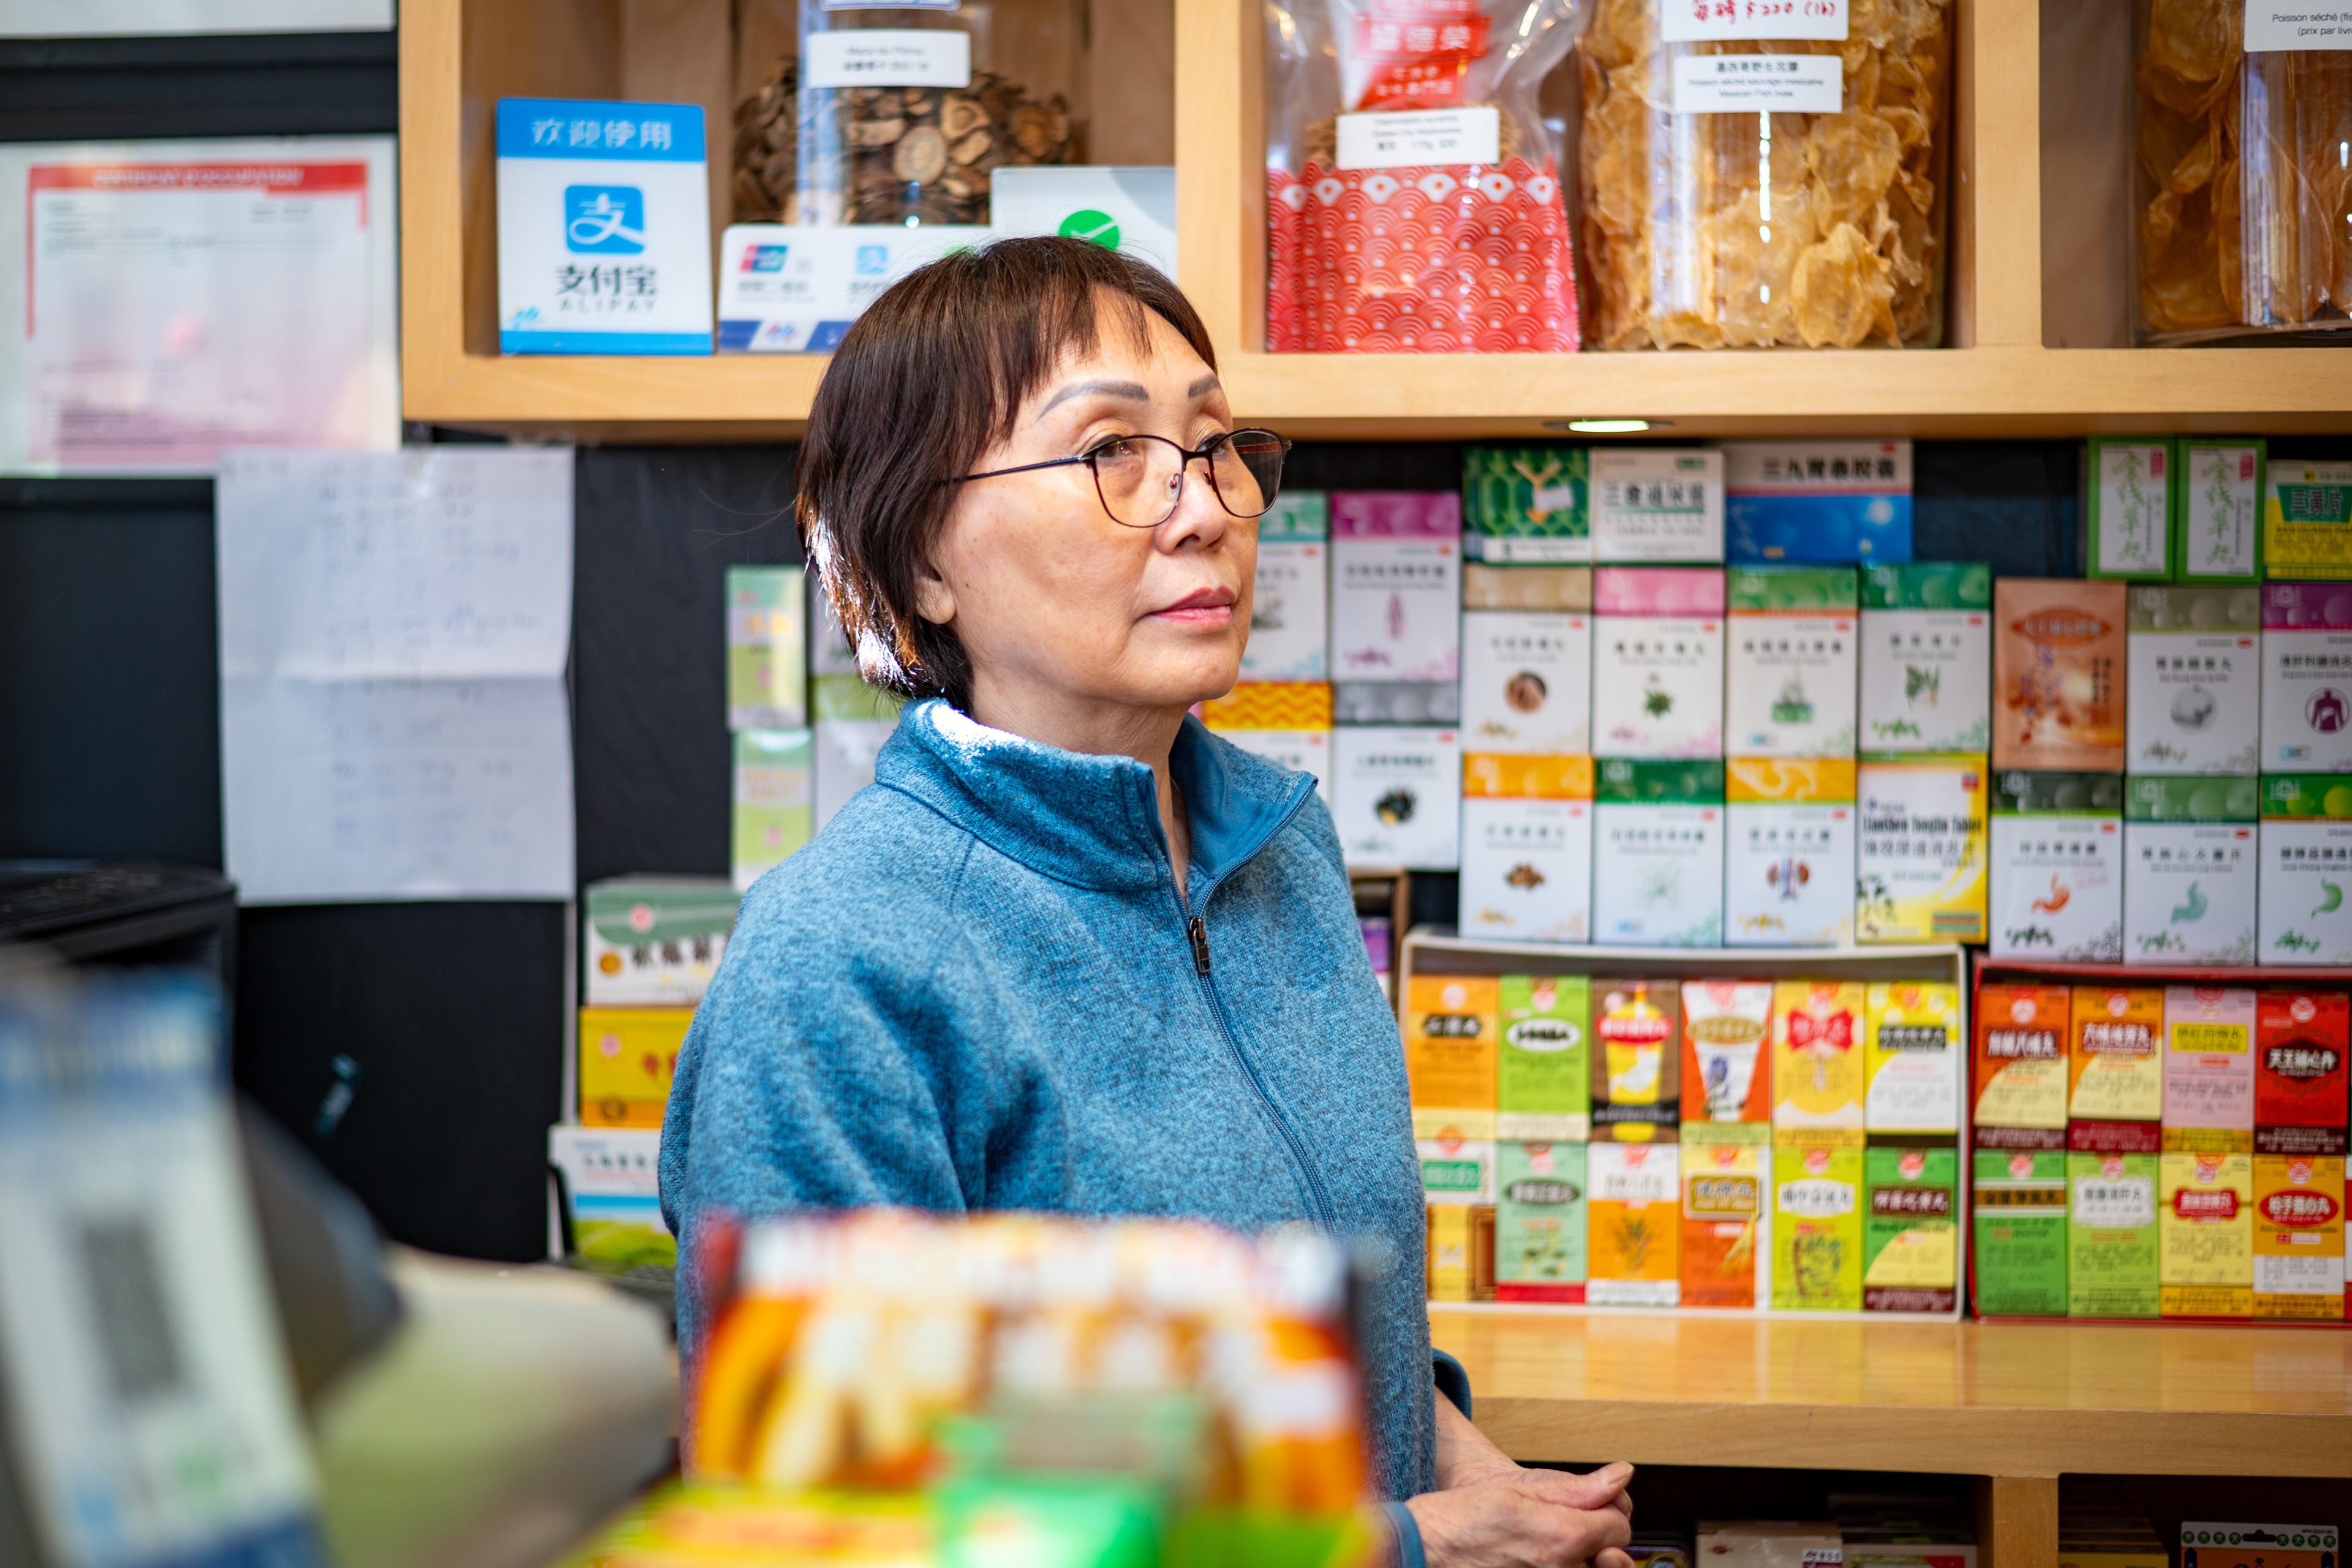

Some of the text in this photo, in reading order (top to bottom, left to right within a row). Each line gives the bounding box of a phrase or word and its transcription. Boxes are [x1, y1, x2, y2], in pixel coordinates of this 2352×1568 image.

[2272, 13, 2307, 22] Poisson
[2310, 12, 2338, 21] séché
[2298, 27, 2318, 37] (prix
[2320, 28, 2336, 36] par
[532, 118, 672, 151] 欢迎使用
[556, 265, 657, 297] 支付宝
[559, 297, 656, 314] ALIPAY
